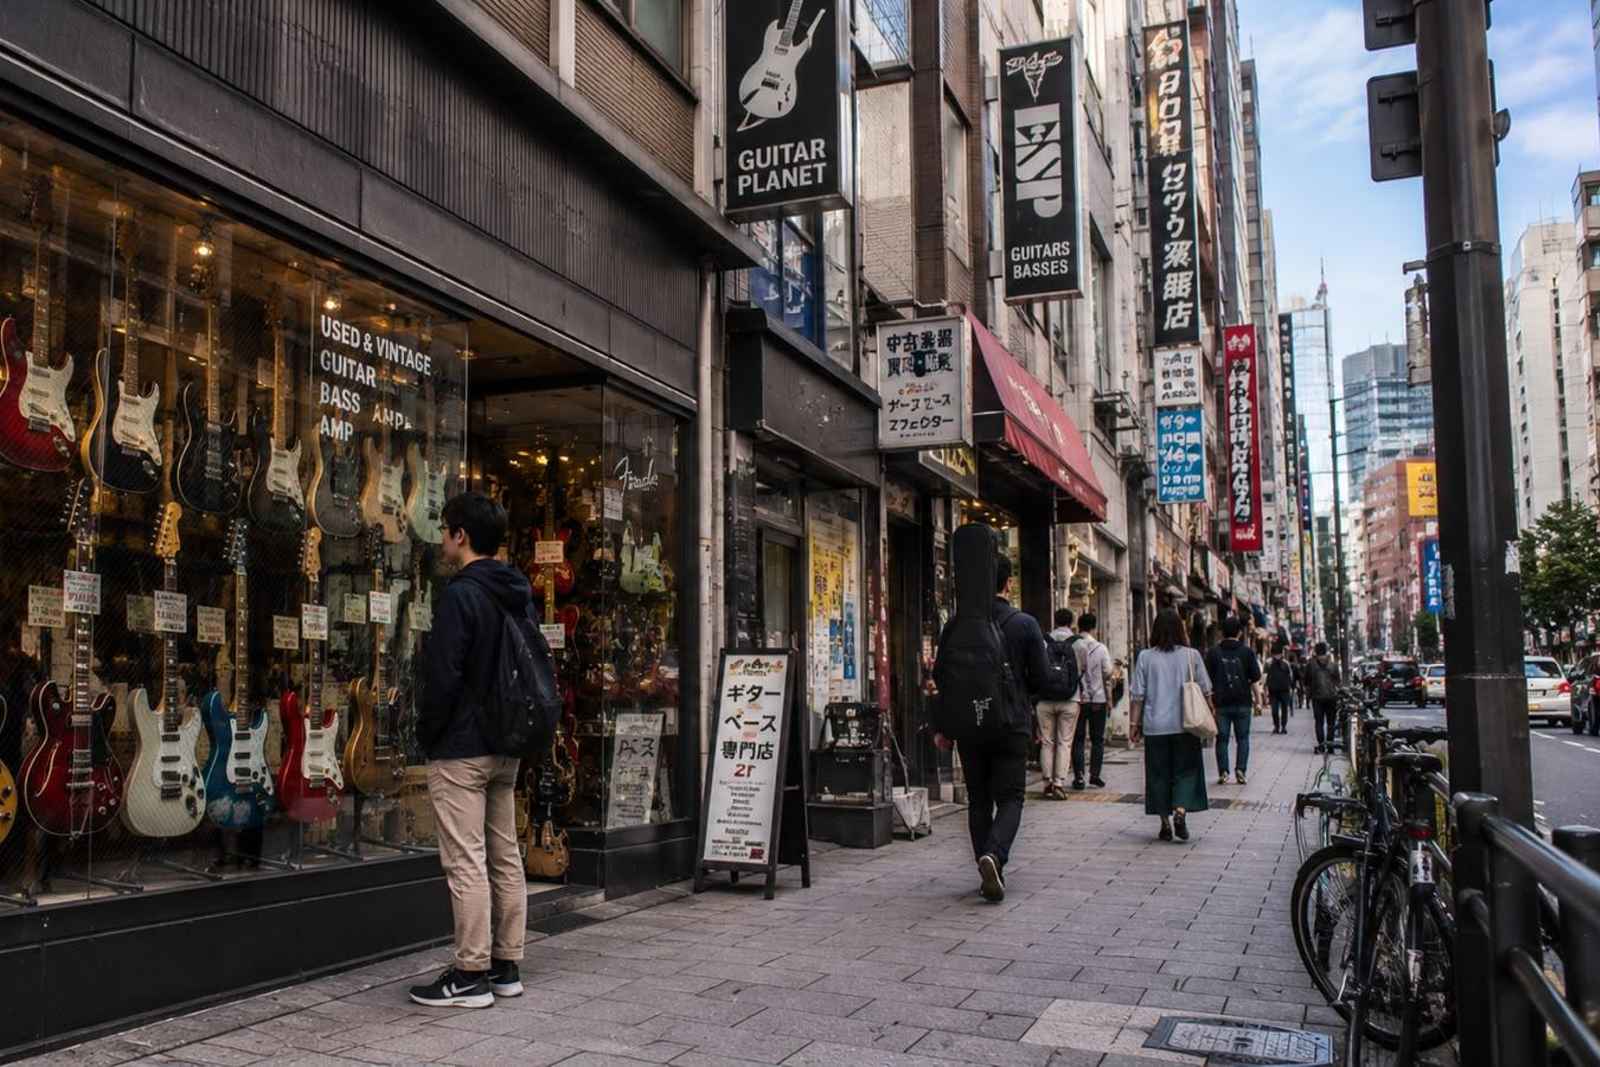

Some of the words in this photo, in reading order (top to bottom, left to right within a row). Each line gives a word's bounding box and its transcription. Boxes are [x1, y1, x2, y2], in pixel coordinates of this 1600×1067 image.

[738, 138, 827, 172] GUITAR
[738, 162, 828, 196] PLANET
[1011, 240, 1071, 262] GUITARS
[1013, 259, 1069, 279] BASSES
[320, 314, 361, 349] USED
[363, 332, 374, 354] &
[375, 335, 432, 377] VINTAGE
[320, 349, 377, 388] GUITAR
[320, 381, 361, 415] BASS
[320, 414, 354, 442] AMP
[727, 683, 782, 703] ギター
[724, 709, 777, 733] ベース
[720, 741, 775, 761] 専門店
